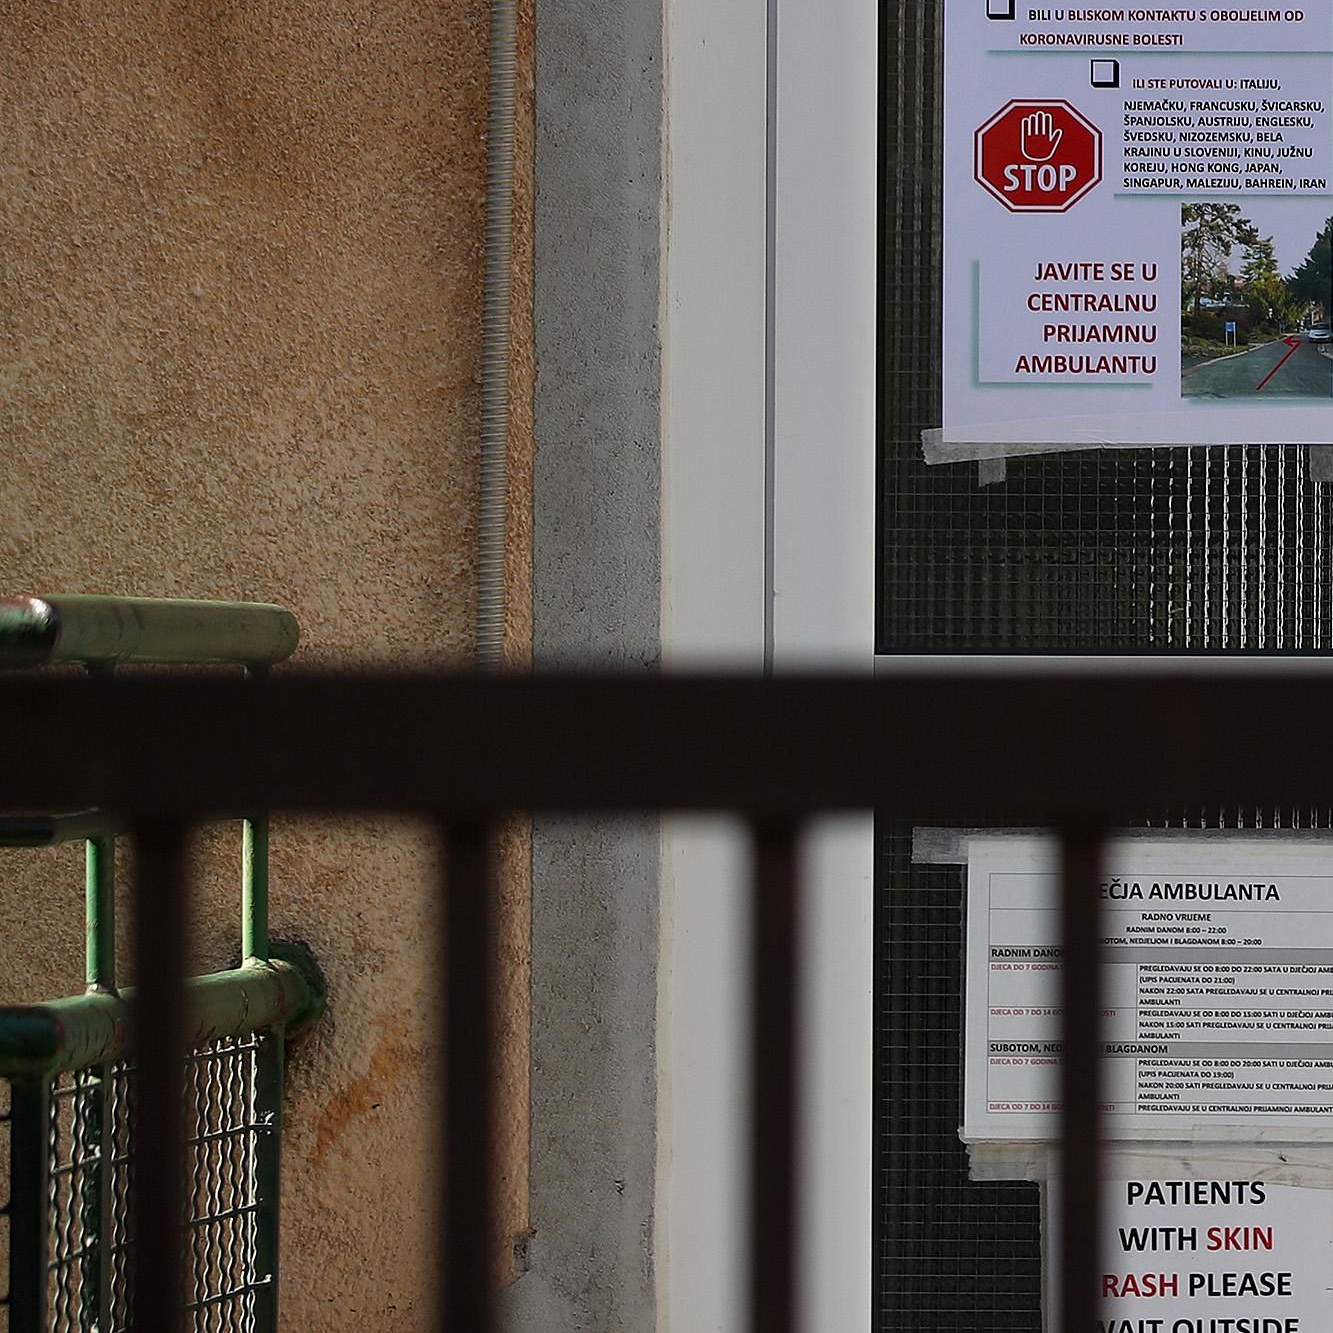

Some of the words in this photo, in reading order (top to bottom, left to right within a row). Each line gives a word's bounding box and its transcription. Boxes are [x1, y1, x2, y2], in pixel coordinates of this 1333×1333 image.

[1028, 9, 1051, 21] BILI
[1054, 9, 1065, 21] U
[1068, 9, 1125, 22] BLISKOM
[1128, 9, 1196, 22] KONTAKTU
[1199, 10, 1207, 22] S
[1210, 10, 1281, 22] OBOLJELIM
[1284, 10, 1304, 22] OD
[1020, 33, 1130, 46] KORONAVIRUSNE
[1132, 33, 1183, 46] BOLESTI
[1003, 164, 1077, 193] STOP
[1034, 262, 1105, 281] JAVITE
[1110, 263, 1135, 281] SE
[1142, 263, 1157, 282] U
[1027, 293, 1157, 313] CENTRALNU
[1043, 324, 1157, 343] PRIJAMNU
[1014, 355, 1157, 374] AMBULANTU
[1148, 882, 1281, 902] AMBULANTA
[990, 948, 1032, 959] RADNIM
[989, 1043, 1042, 1055] SUBOTOM,
[1105, 1044, 1169, 1055] BLAGDANOM
[1127, 1180, 1266, 1206] PATIENTS
[1118, 1227, 1197, 1252] WITH
[1206, 1226, 1273, 1251] SKIN
[1102, 1273, 1178, 1298] RASH
[1189, 1272, 1292, 1297] PLEASE
